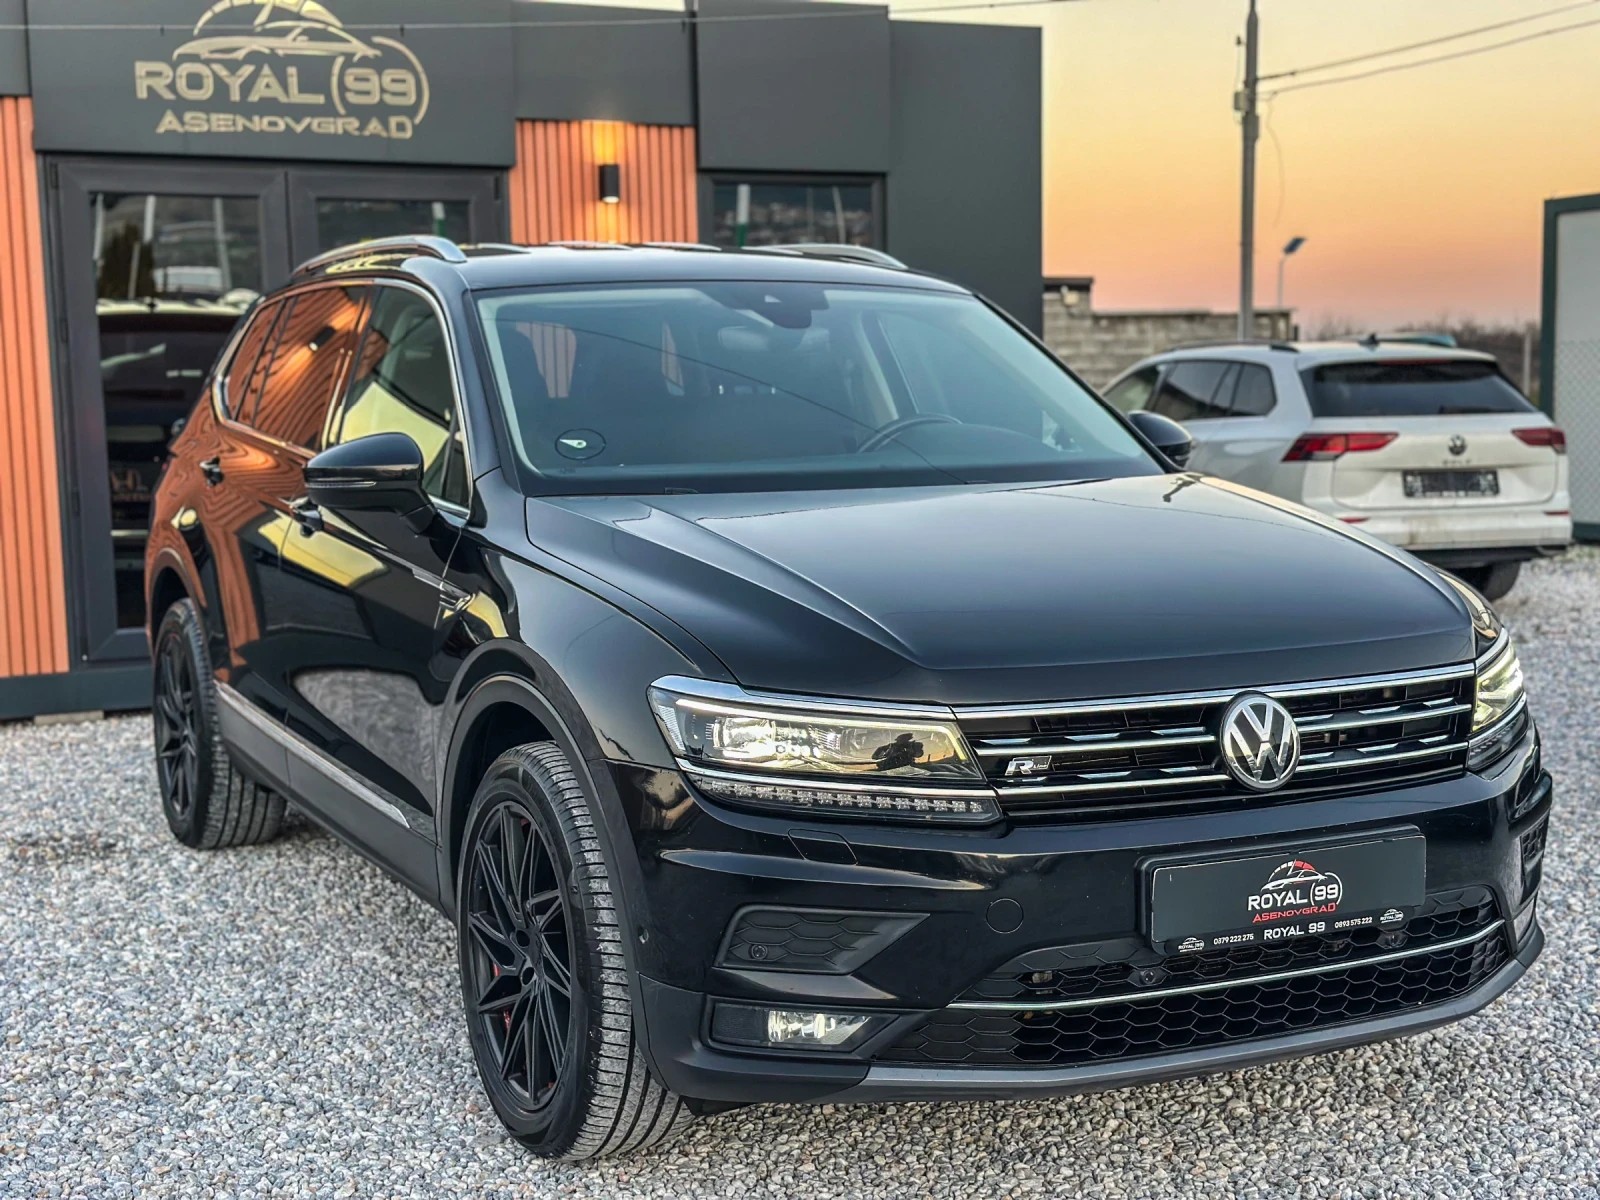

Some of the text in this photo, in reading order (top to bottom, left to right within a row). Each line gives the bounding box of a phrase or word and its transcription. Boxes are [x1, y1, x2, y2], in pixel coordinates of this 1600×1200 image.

[134, 60, 325, 104] ROYAL
[155, 108, 413, 139] ASENOVGRAD
[1247, 889, 1308, 911] ROYAL
[1252, 902, 1336, 923] ASENOVGRAD
[1334, 921, 1350, 929] 0893
[1350, 918, 1361, 926] 575
[1361, 916, 1373, 925] 222
[1213, 937, 1229, 945] 0379
[1229, 935, 1242, 943] 222
[1263, 921, 1326, 940] ROYAL 99
